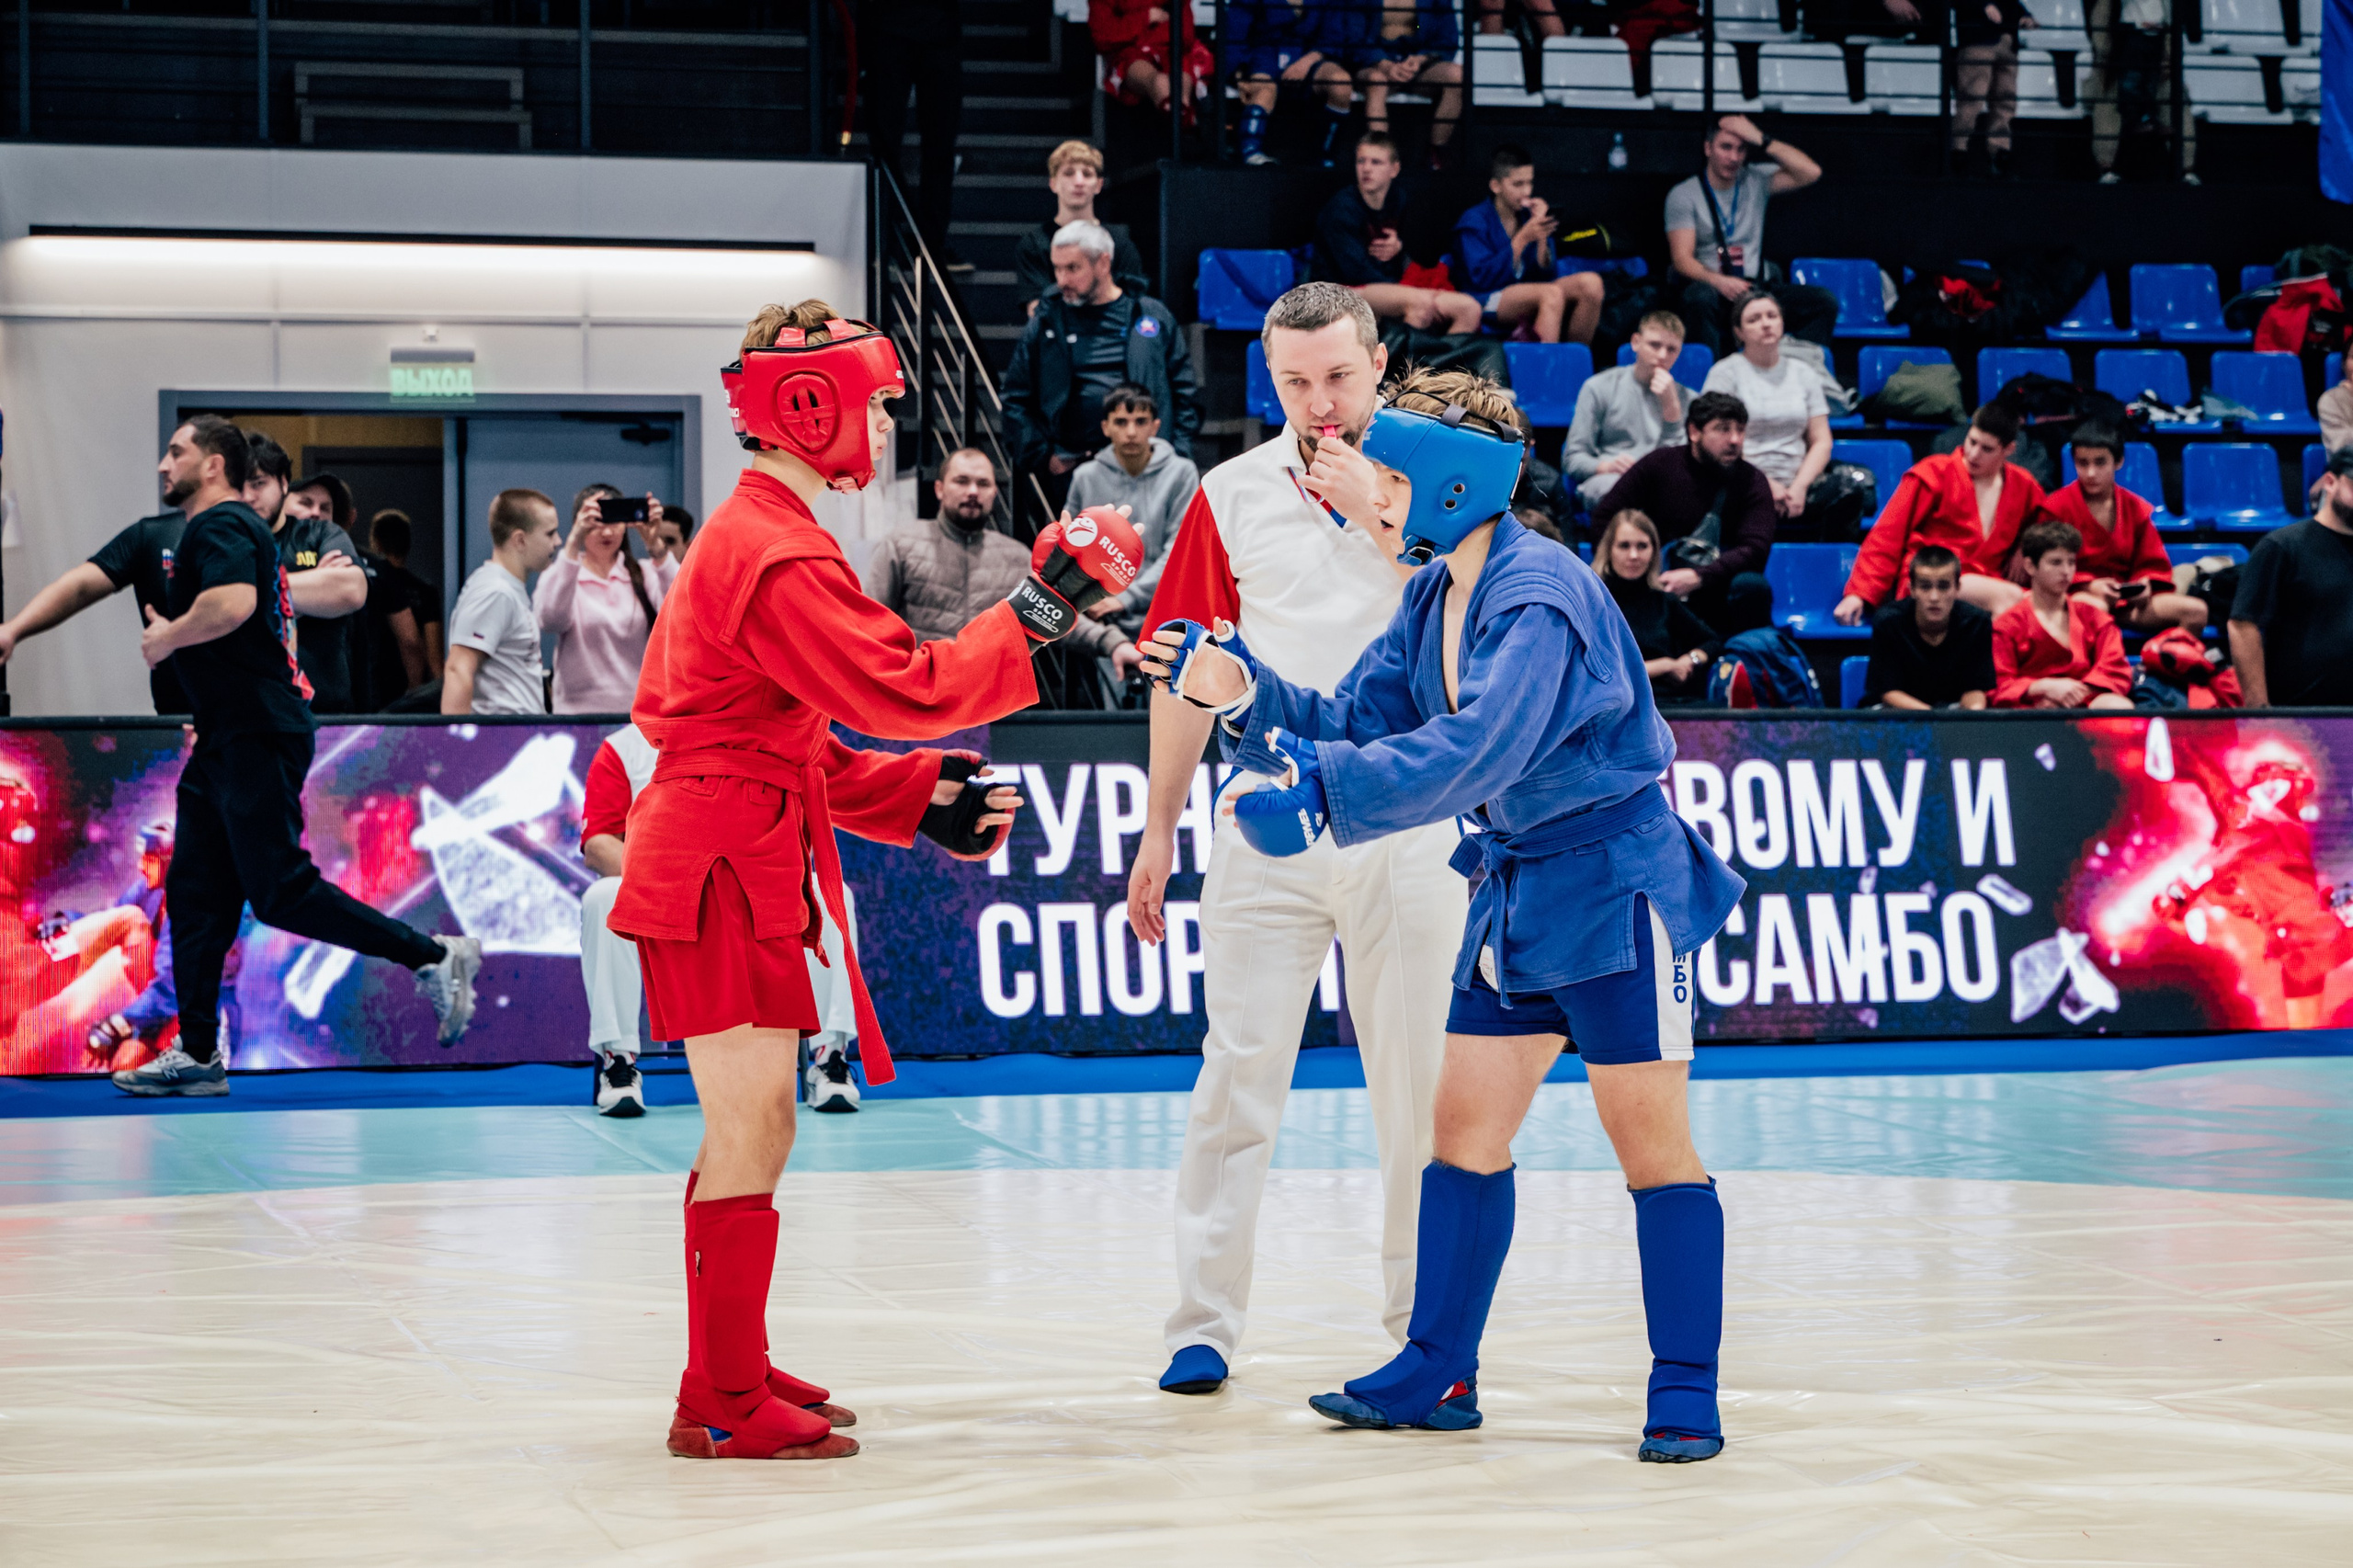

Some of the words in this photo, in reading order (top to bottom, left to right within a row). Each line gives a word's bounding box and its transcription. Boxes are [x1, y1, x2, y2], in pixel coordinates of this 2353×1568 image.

[392, 368, 474, 396] ВЫХОД
[1099, 536, 1136, 576] RUSCO
[1110, 562, 1131, 583] SPORT
[1022, 586, 1063, 619] RUSCO
[1033, 608, 1056, 625] SPORT
[1656, 758, 1926, 869] ВОМУ
[1951, 758, 2017, 866] И
[977, 902, 1205, 1018] СПОР
[1698, 891, 1999, 1006] САМБО
